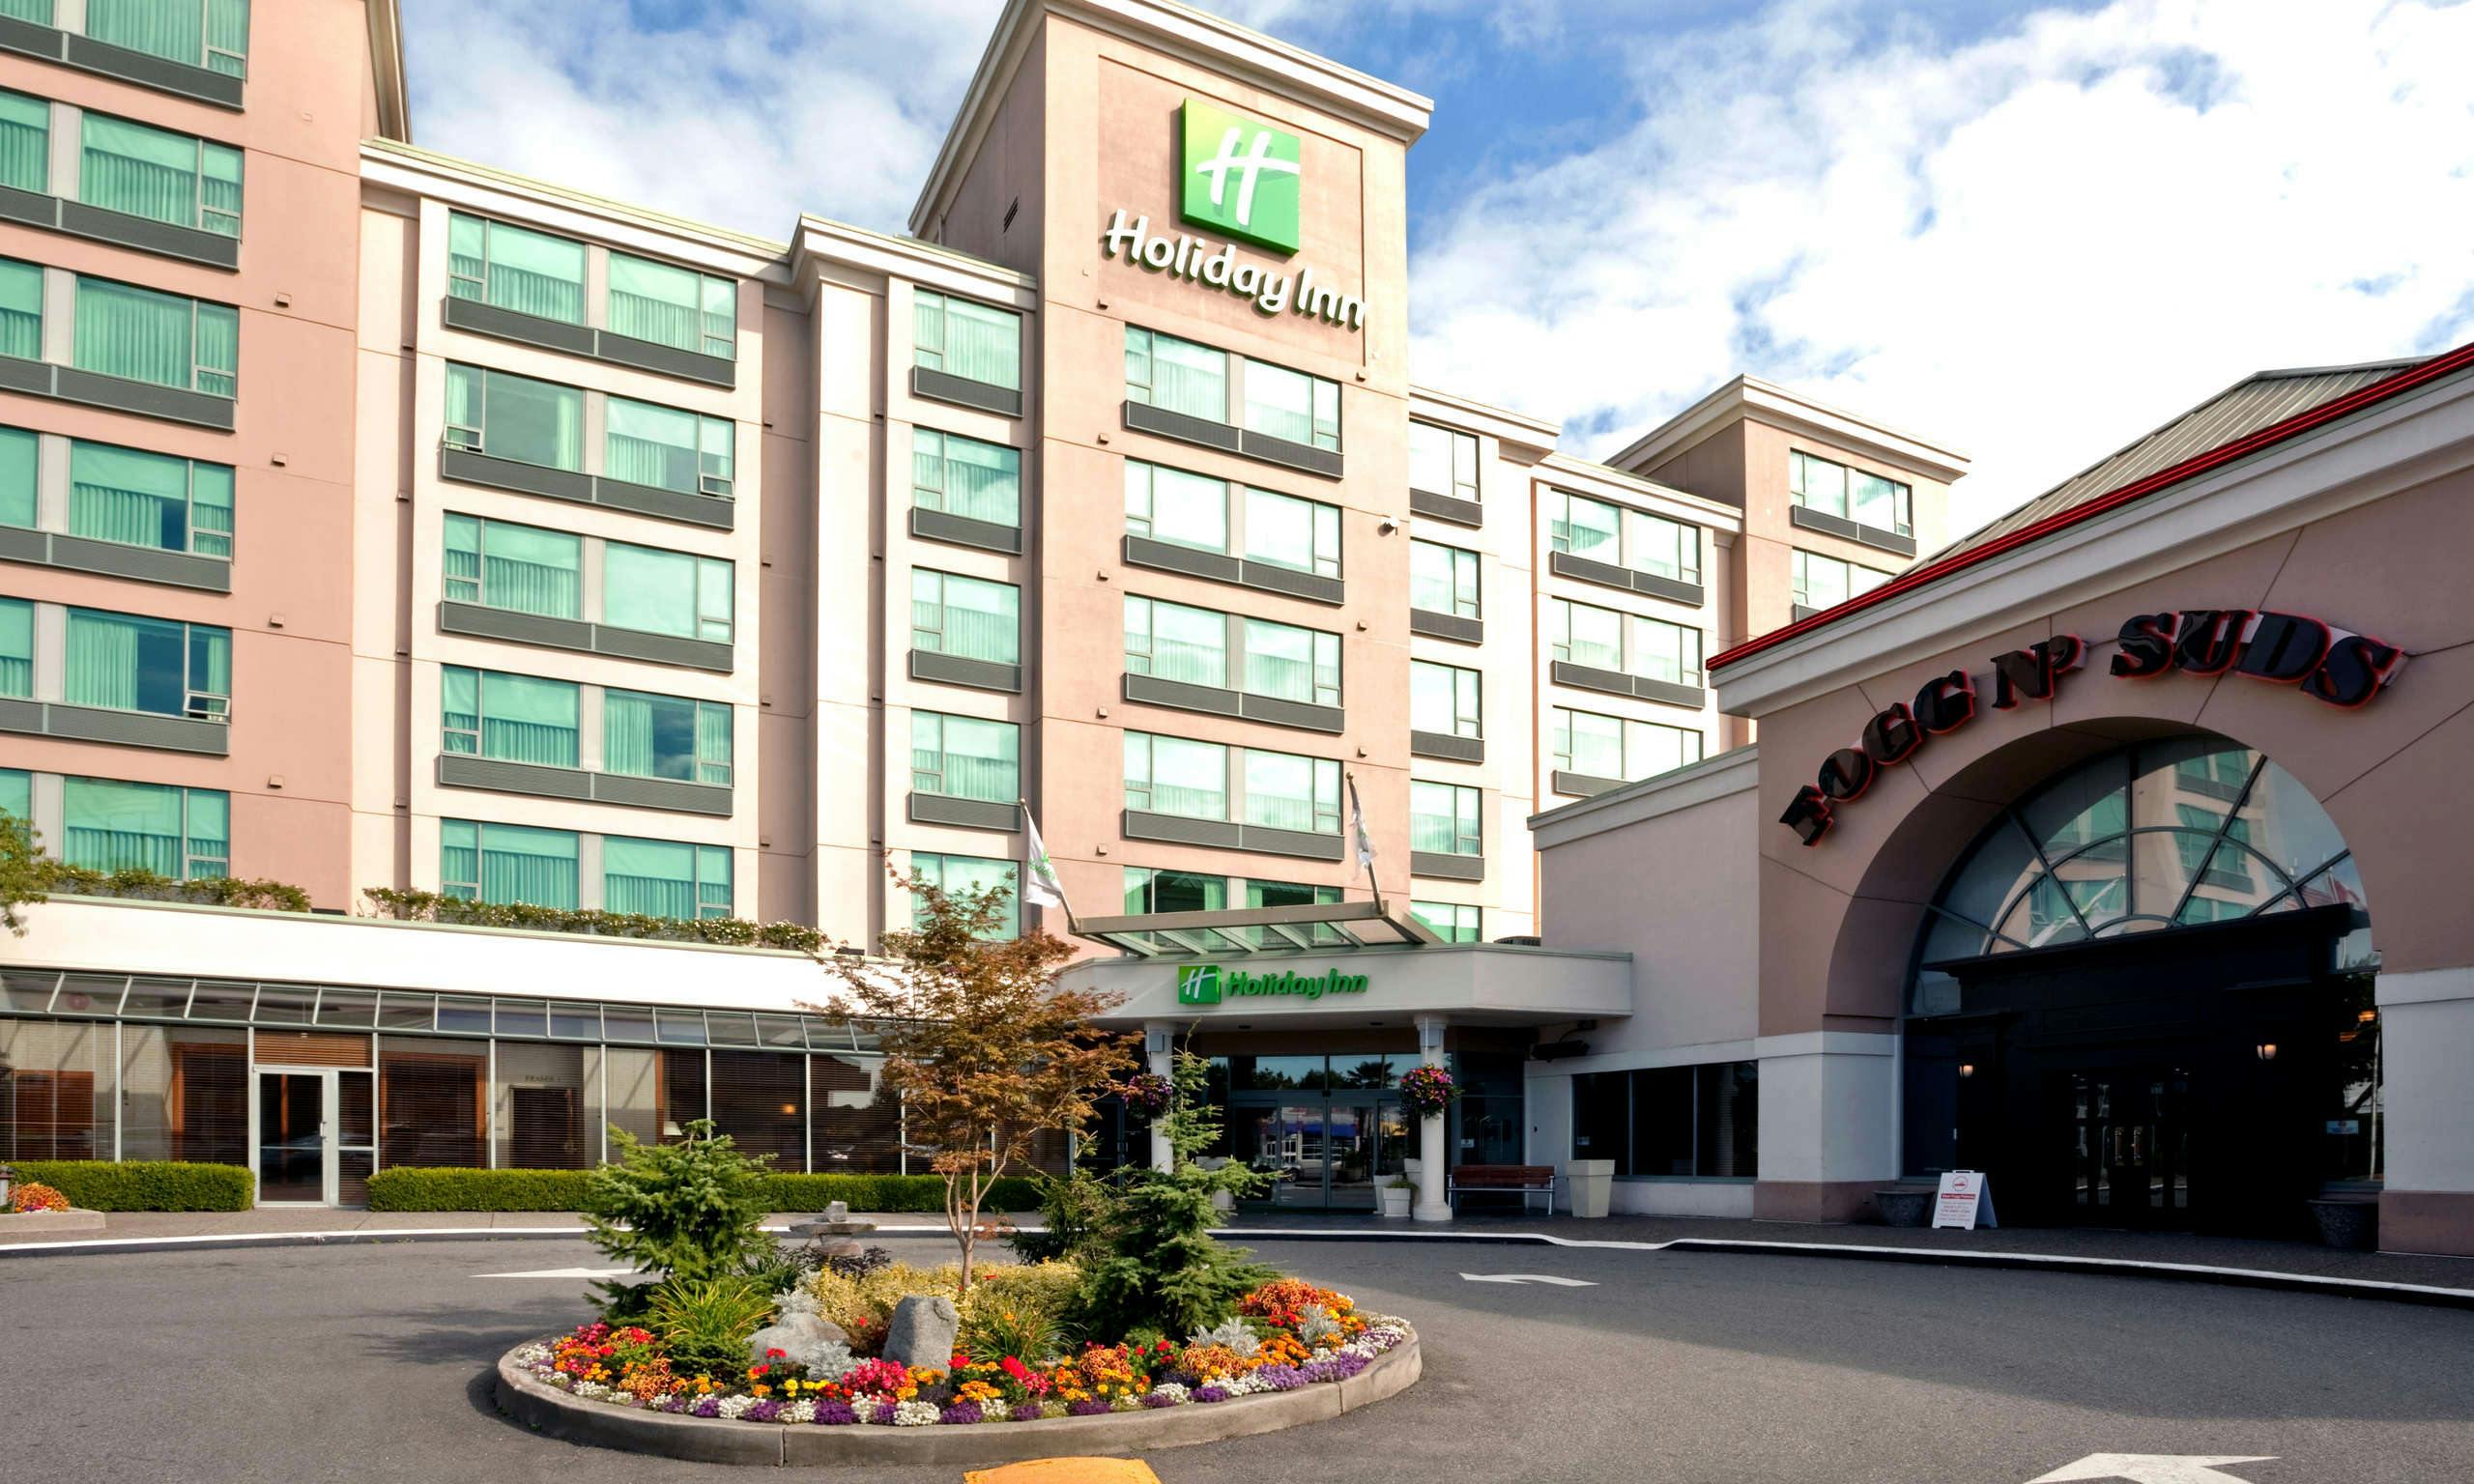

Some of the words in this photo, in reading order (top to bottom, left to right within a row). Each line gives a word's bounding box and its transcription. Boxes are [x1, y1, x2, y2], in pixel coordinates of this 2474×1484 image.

[1106, 208, 1292, 314] Holiday
[1295, 267, 1366, 331] Inn
[1778, 670, 1976, 847] FOGG
[2110, 609, 2404, 710] SUDS
[1226, 970, 1325, 1000] Holiday
[1327, 968, 1369, 994] Inn
